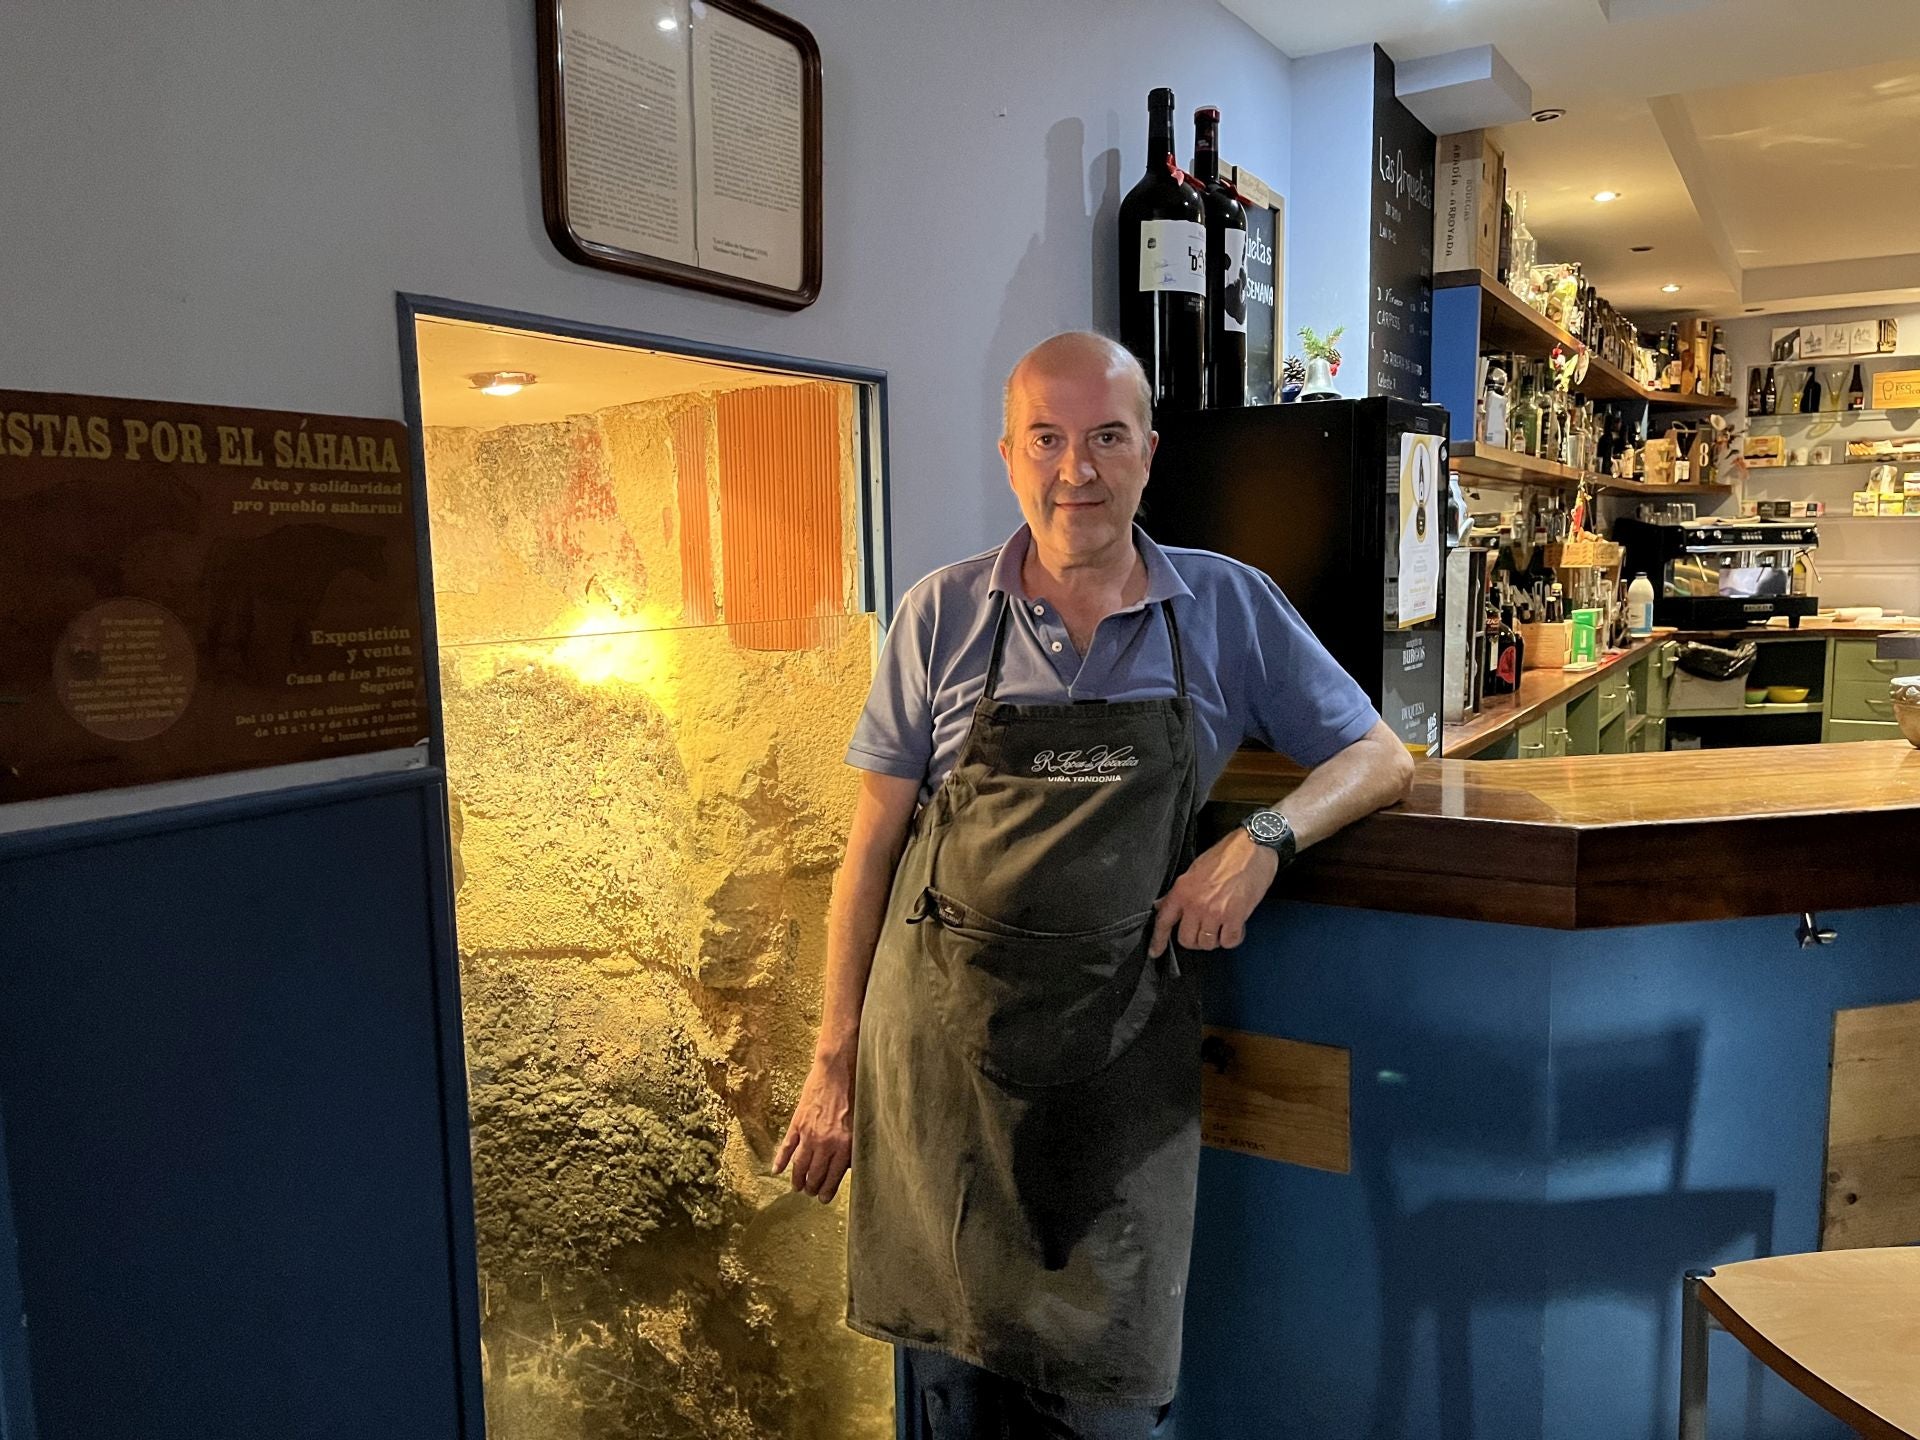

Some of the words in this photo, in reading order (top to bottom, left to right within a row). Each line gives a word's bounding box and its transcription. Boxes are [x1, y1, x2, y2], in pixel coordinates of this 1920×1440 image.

[1379, 137, 1395, 183] Las
[1464, 179, 1473, 222] BODEGAS
[1446, 199, 1458, 257] ARROYADA
[1247, 278, 1274, 307] SEMANA
[122, 418, 207, 464] POR
[216, 425, 263, 466] EL
[273, 419, 401, 473] SÁHARA
[1699, 443, 1709, 467] 8
[251, 477, 289, 493] Arte
[293, 481, 305, 496] y
[309, 480, 402, 496] solidaridad
[231, 500, 263, 515] pro
[269, 500, 326, 515] pueblo
[310, 625, 411, 647] Exposición
[346, 649, 358, 664] y
[363, 643, 412, 659] venta
[286, 673, 323, 686] Casa
[328, 670, 345, 682] de
[350, 668, 371, 681] los
[376, 665, 414, 678] Picos
[360, 680, 414, 695] Segovia
[235, 715, 256, 726] Del
[260, 713, 275, 723] 10
[278, 711, 290, 721] al
[310, 706, 325, 717] de
[326, 702, 382, 717] diciembre
[254, 727, 270, 738] de
[291, 724, 298, 733] a
[328, 718, 343, 729] de
[387, 712, 418, 724] horas
[321, 734, 336, 744] de
[338, 730, 370, 742] lunes
[379, 725, 419, 737] viernes
[1047, 775, 1072, 783] VIÑA
[1073, 774, 1123, 784] TONDONIA
